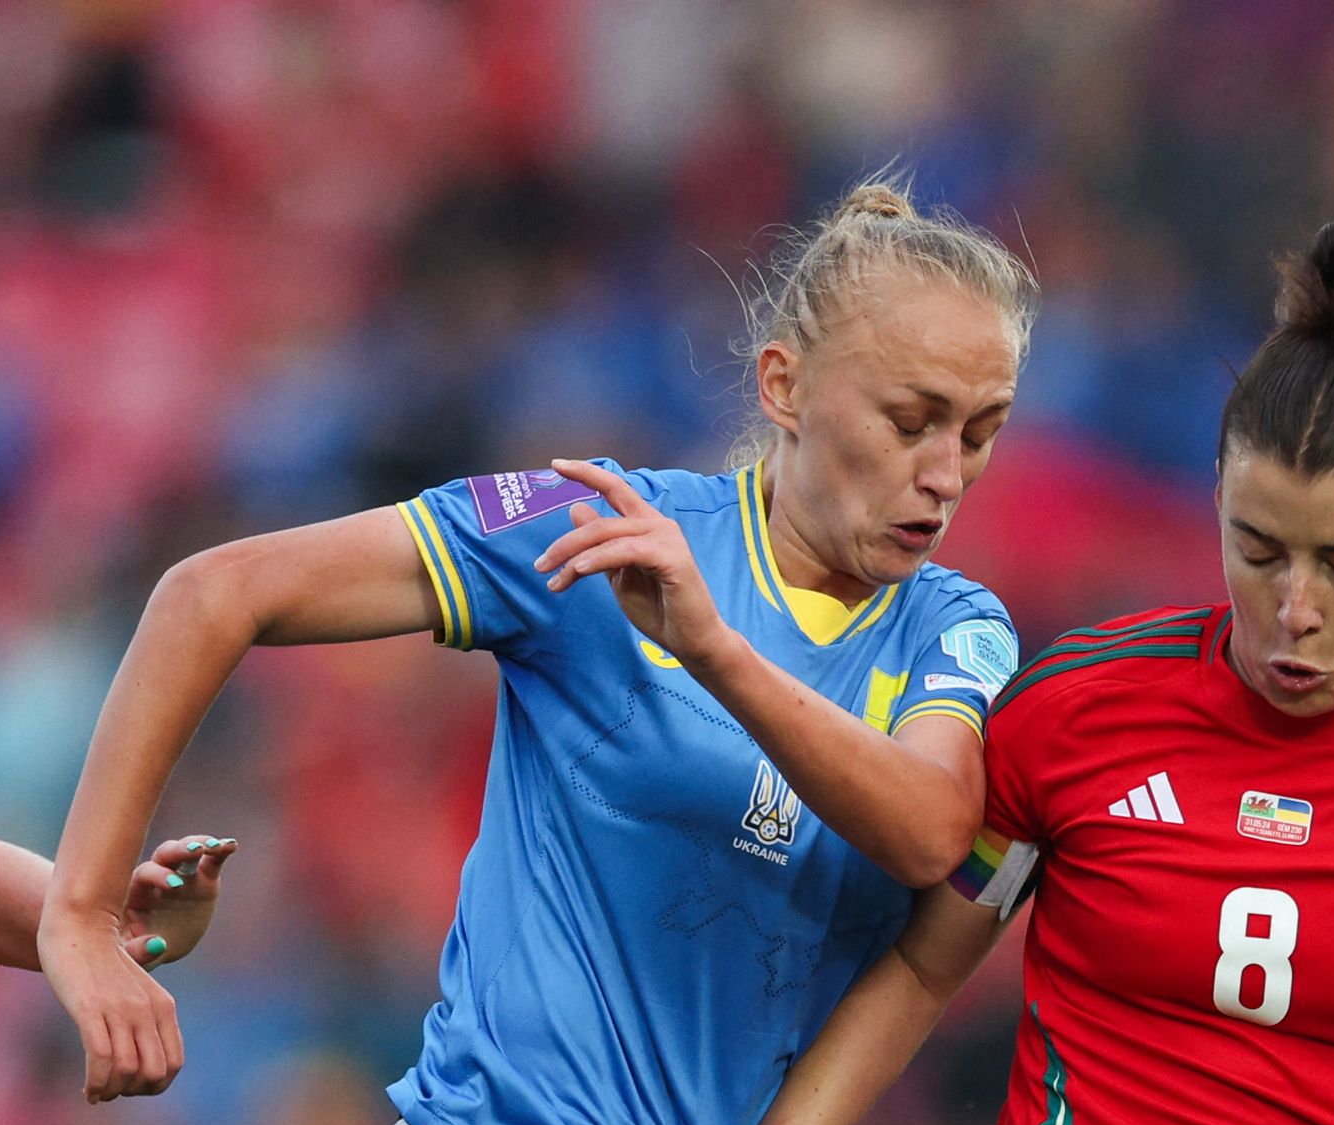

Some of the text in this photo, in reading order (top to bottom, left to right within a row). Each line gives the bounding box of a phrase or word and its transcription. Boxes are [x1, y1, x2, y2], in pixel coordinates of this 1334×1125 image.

[505, 472, 527, 514] ROPEAN
[732, 836, 789, 866] UKRAINE
[1213, 886, 1299, 1026] 8
